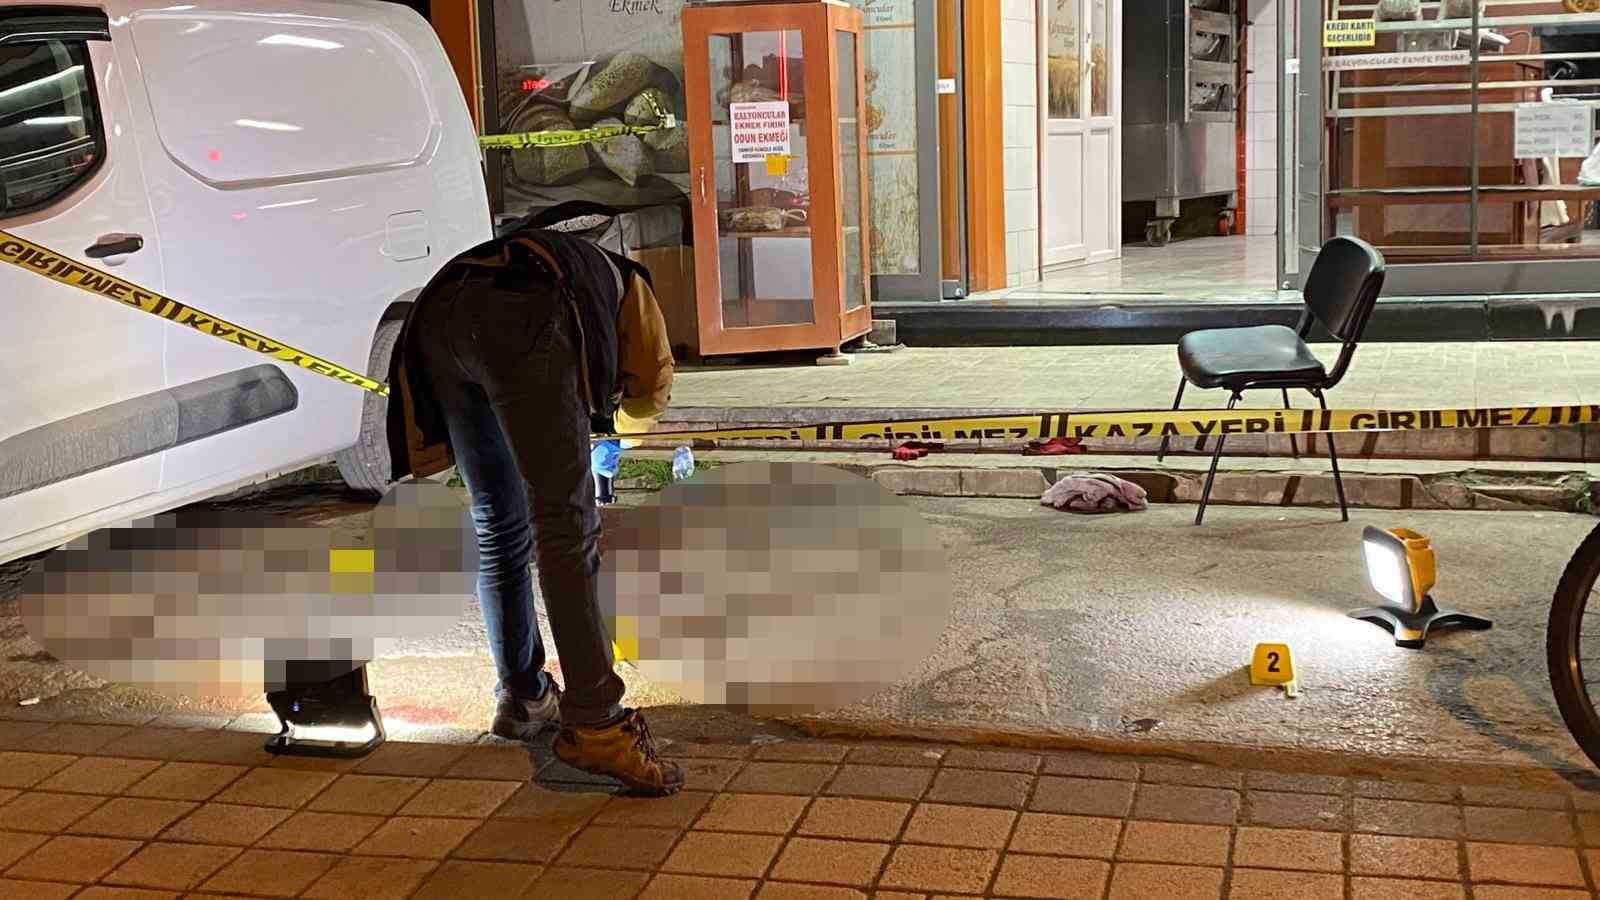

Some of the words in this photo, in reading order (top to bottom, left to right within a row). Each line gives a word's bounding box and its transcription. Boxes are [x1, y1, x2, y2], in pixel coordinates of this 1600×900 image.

[734, 111, 786, 120] KALYONCULAR
[735, 121, 761, 129] EKMEK
[735, 133, 756, 143] ODUN
[1267, 651, 1280, 673] 2
